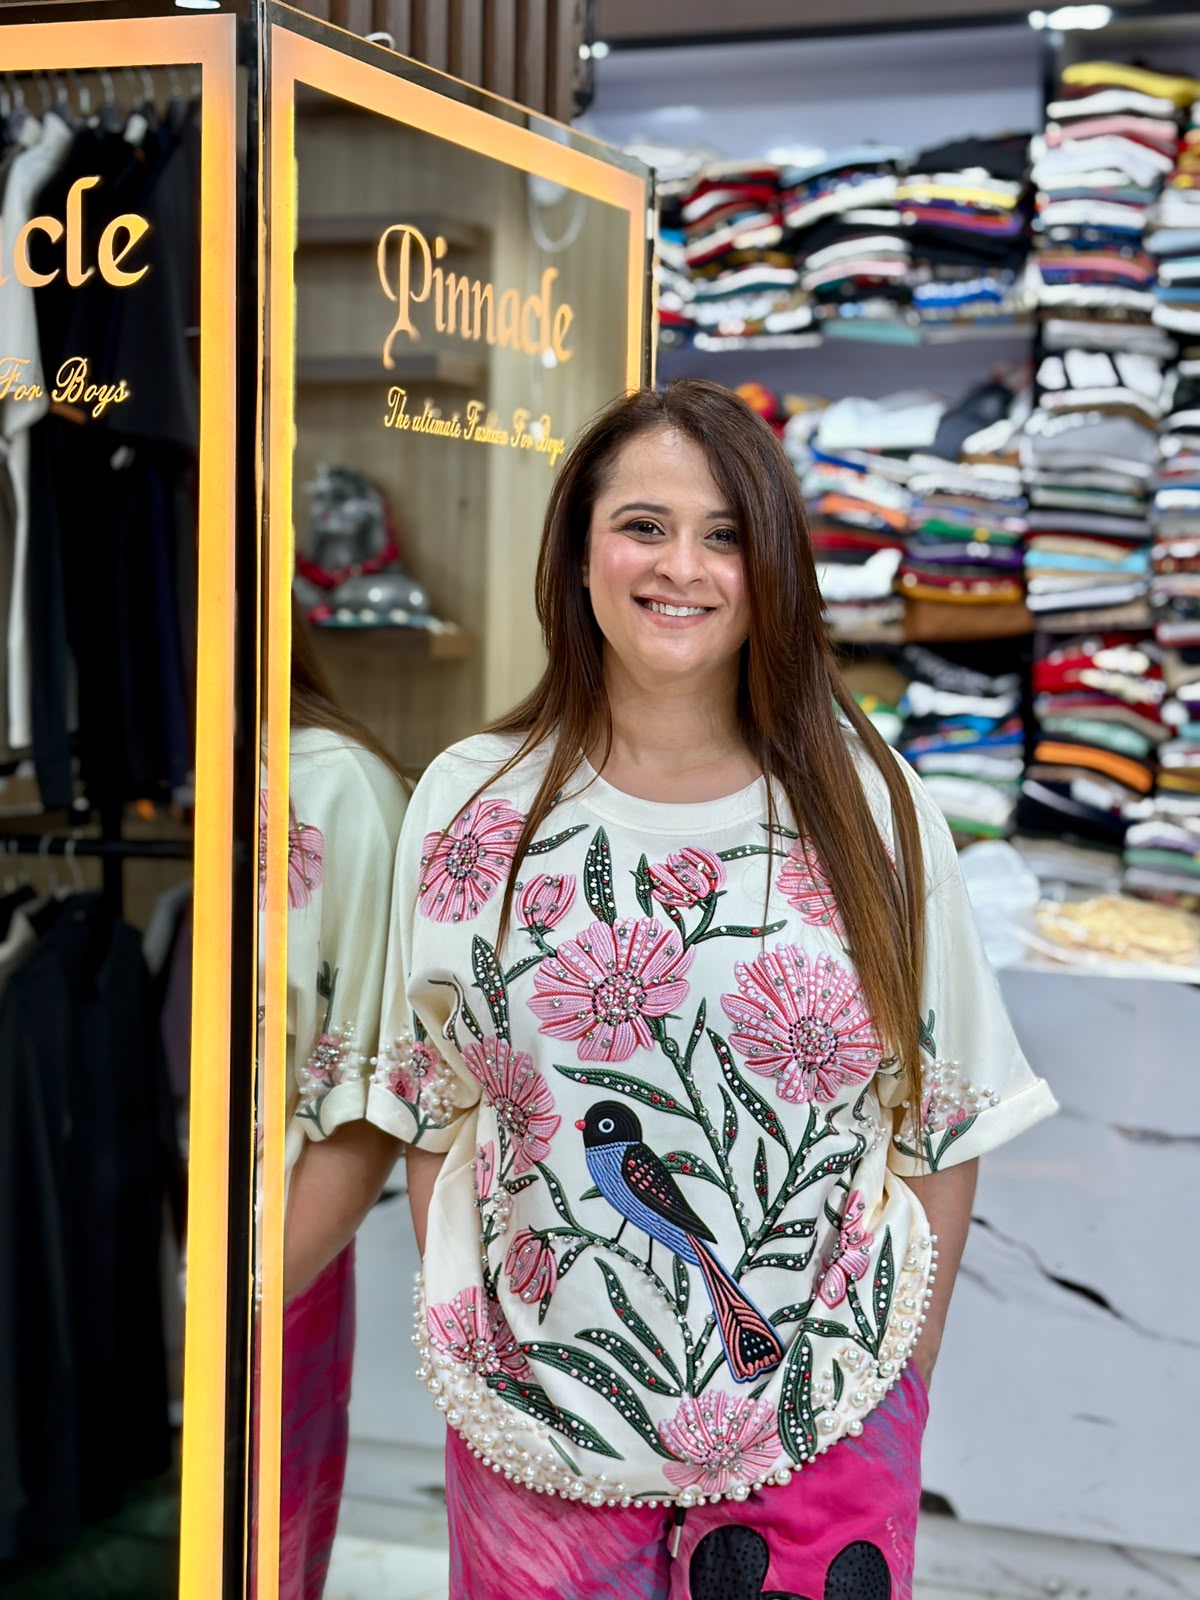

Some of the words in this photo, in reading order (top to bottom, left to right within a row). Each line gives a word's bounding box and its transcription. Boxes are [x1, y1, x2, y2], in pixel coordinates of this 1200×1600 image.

[0, 176, 149, 287] cle
[377, 223, 574, 370] Pinnacle
[0, 356, 42, 400] For
[51, 356, 129, 418] Boys
[384, 386, 410, 430] The
[511, 408, 534, 448] For
